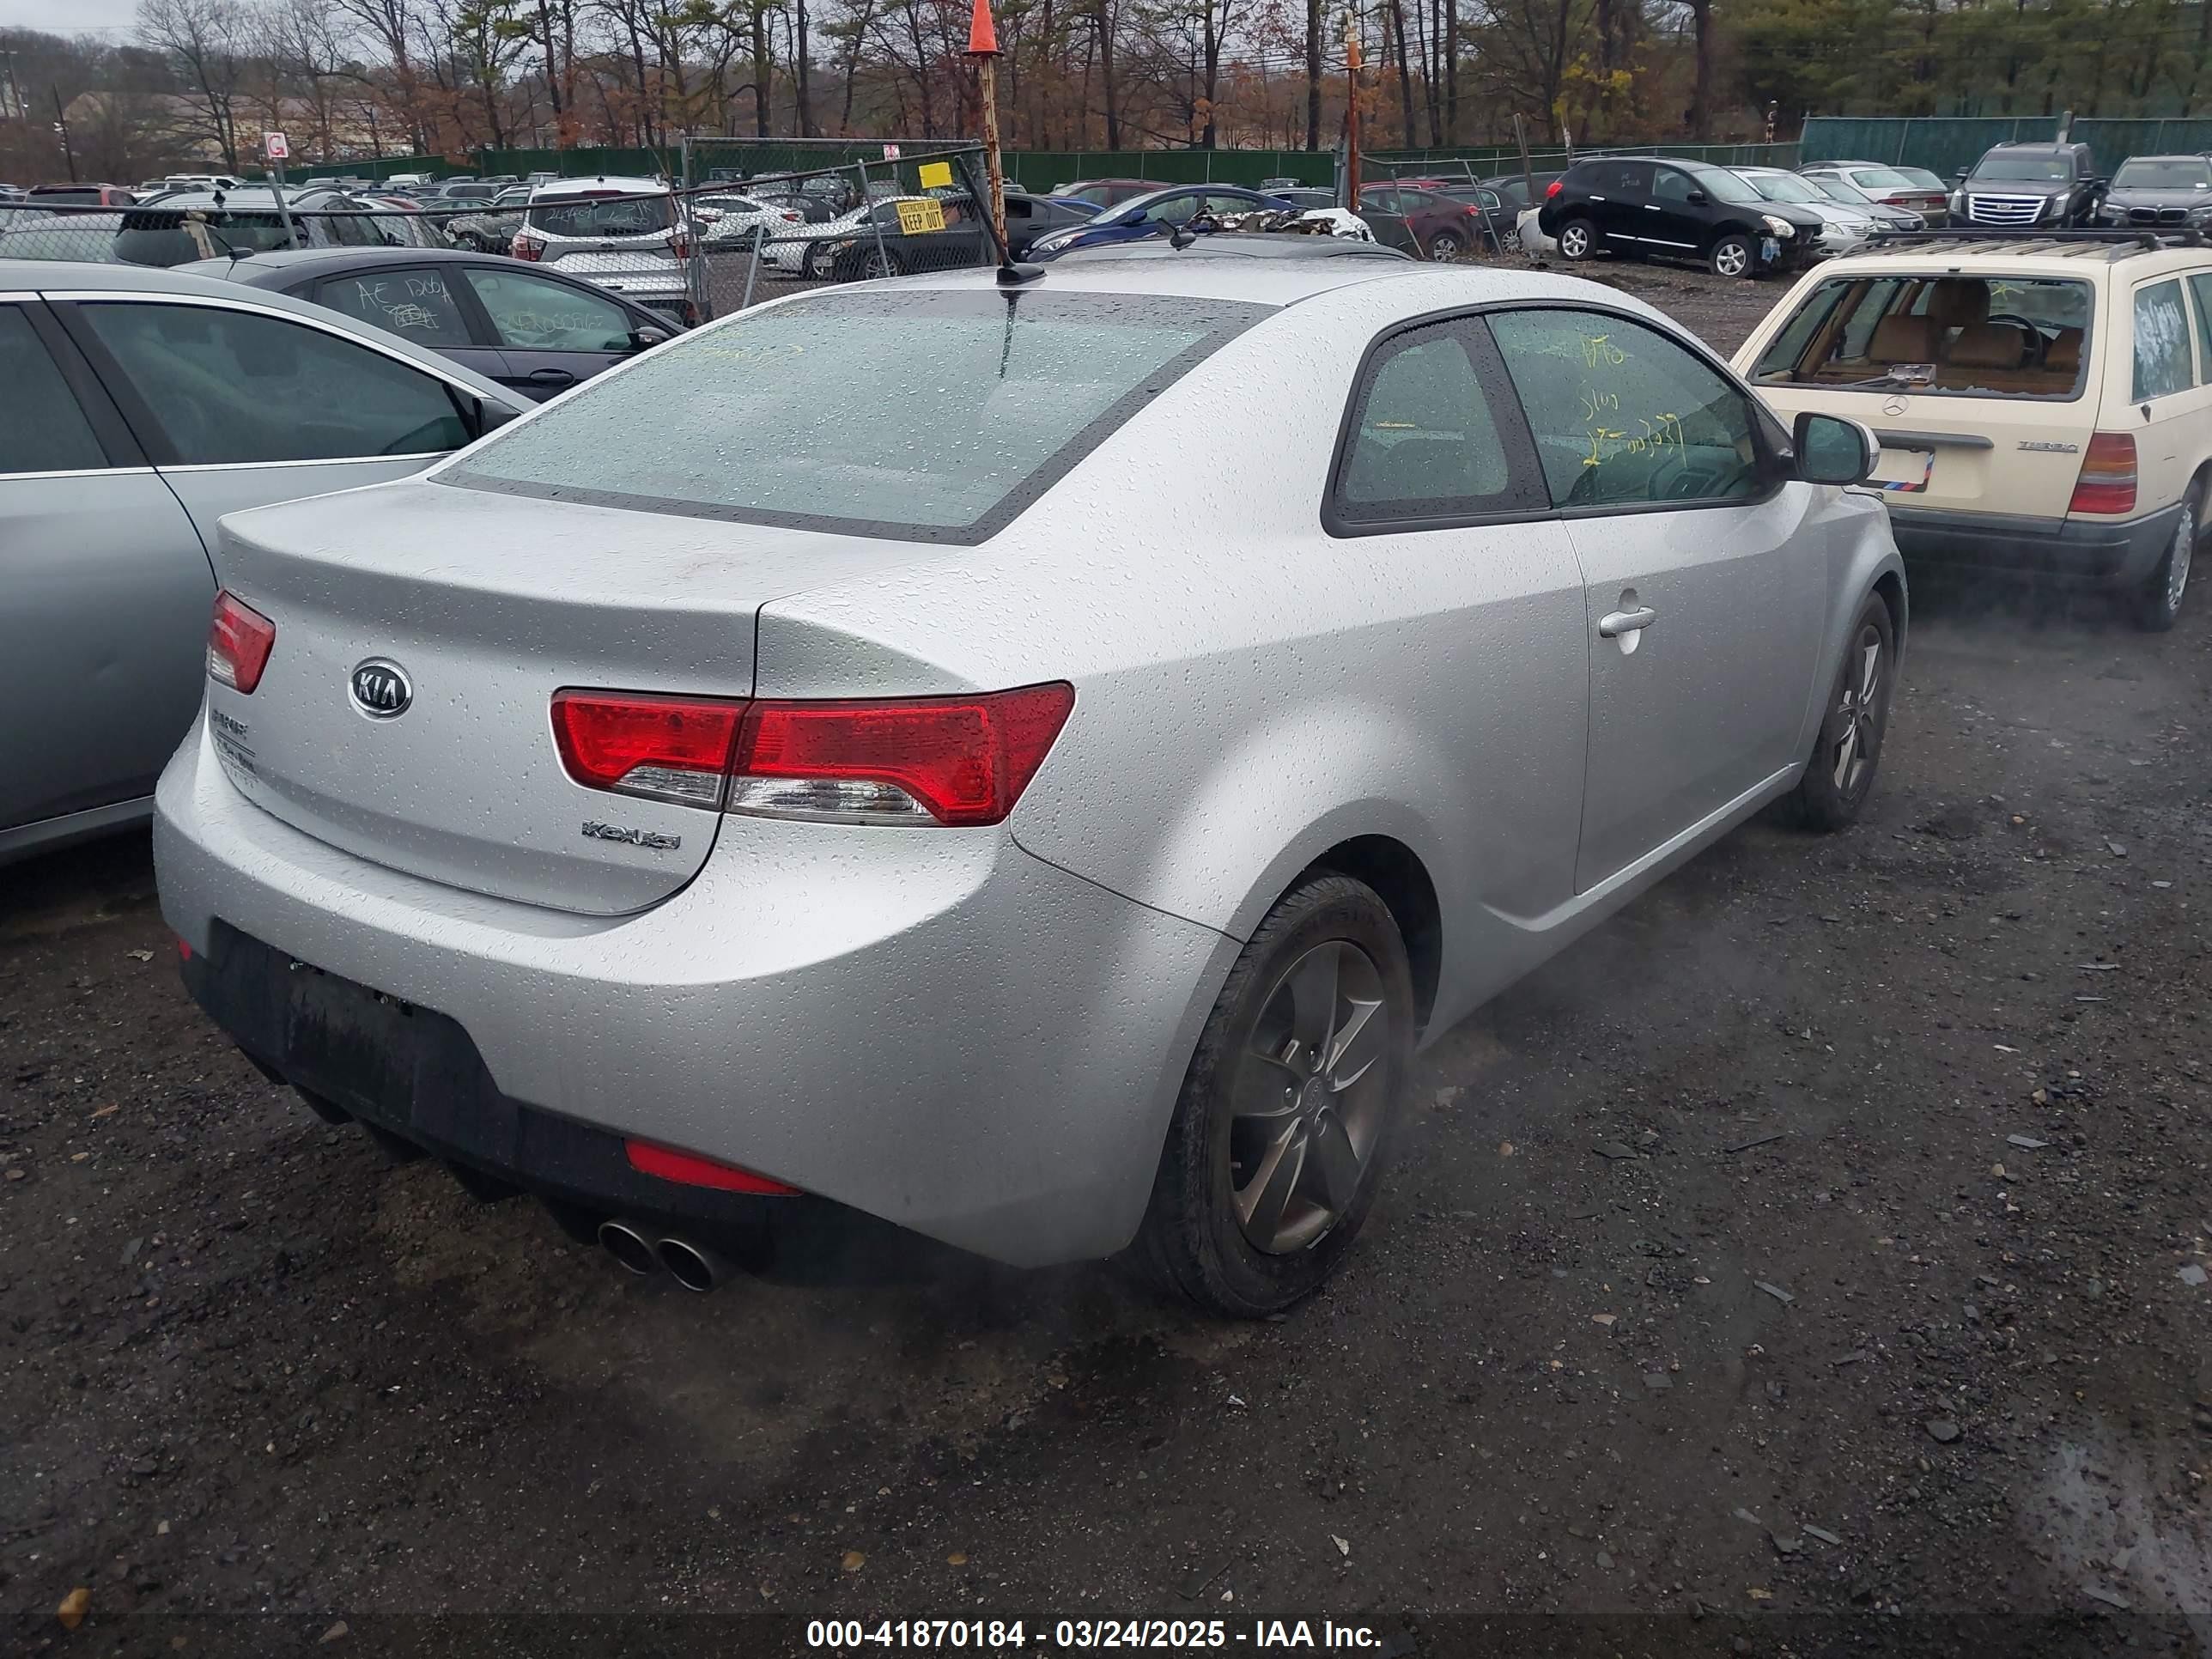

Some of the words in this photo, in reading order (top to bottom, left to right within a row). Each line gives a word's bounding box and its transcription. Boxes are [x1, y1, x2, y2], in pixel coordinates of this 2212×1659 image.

[899, 204, 926, 214] RESTRICTED
[927, 200, 939, 210] AREA
[902, 215, 922, 232] KEEP
[926, 211, 942, 228] OUT
[2018, 441, 2079, 453] TURBO
[358, 672, 398, 708] KIA
[580, 819, 682, 850] KOUP
